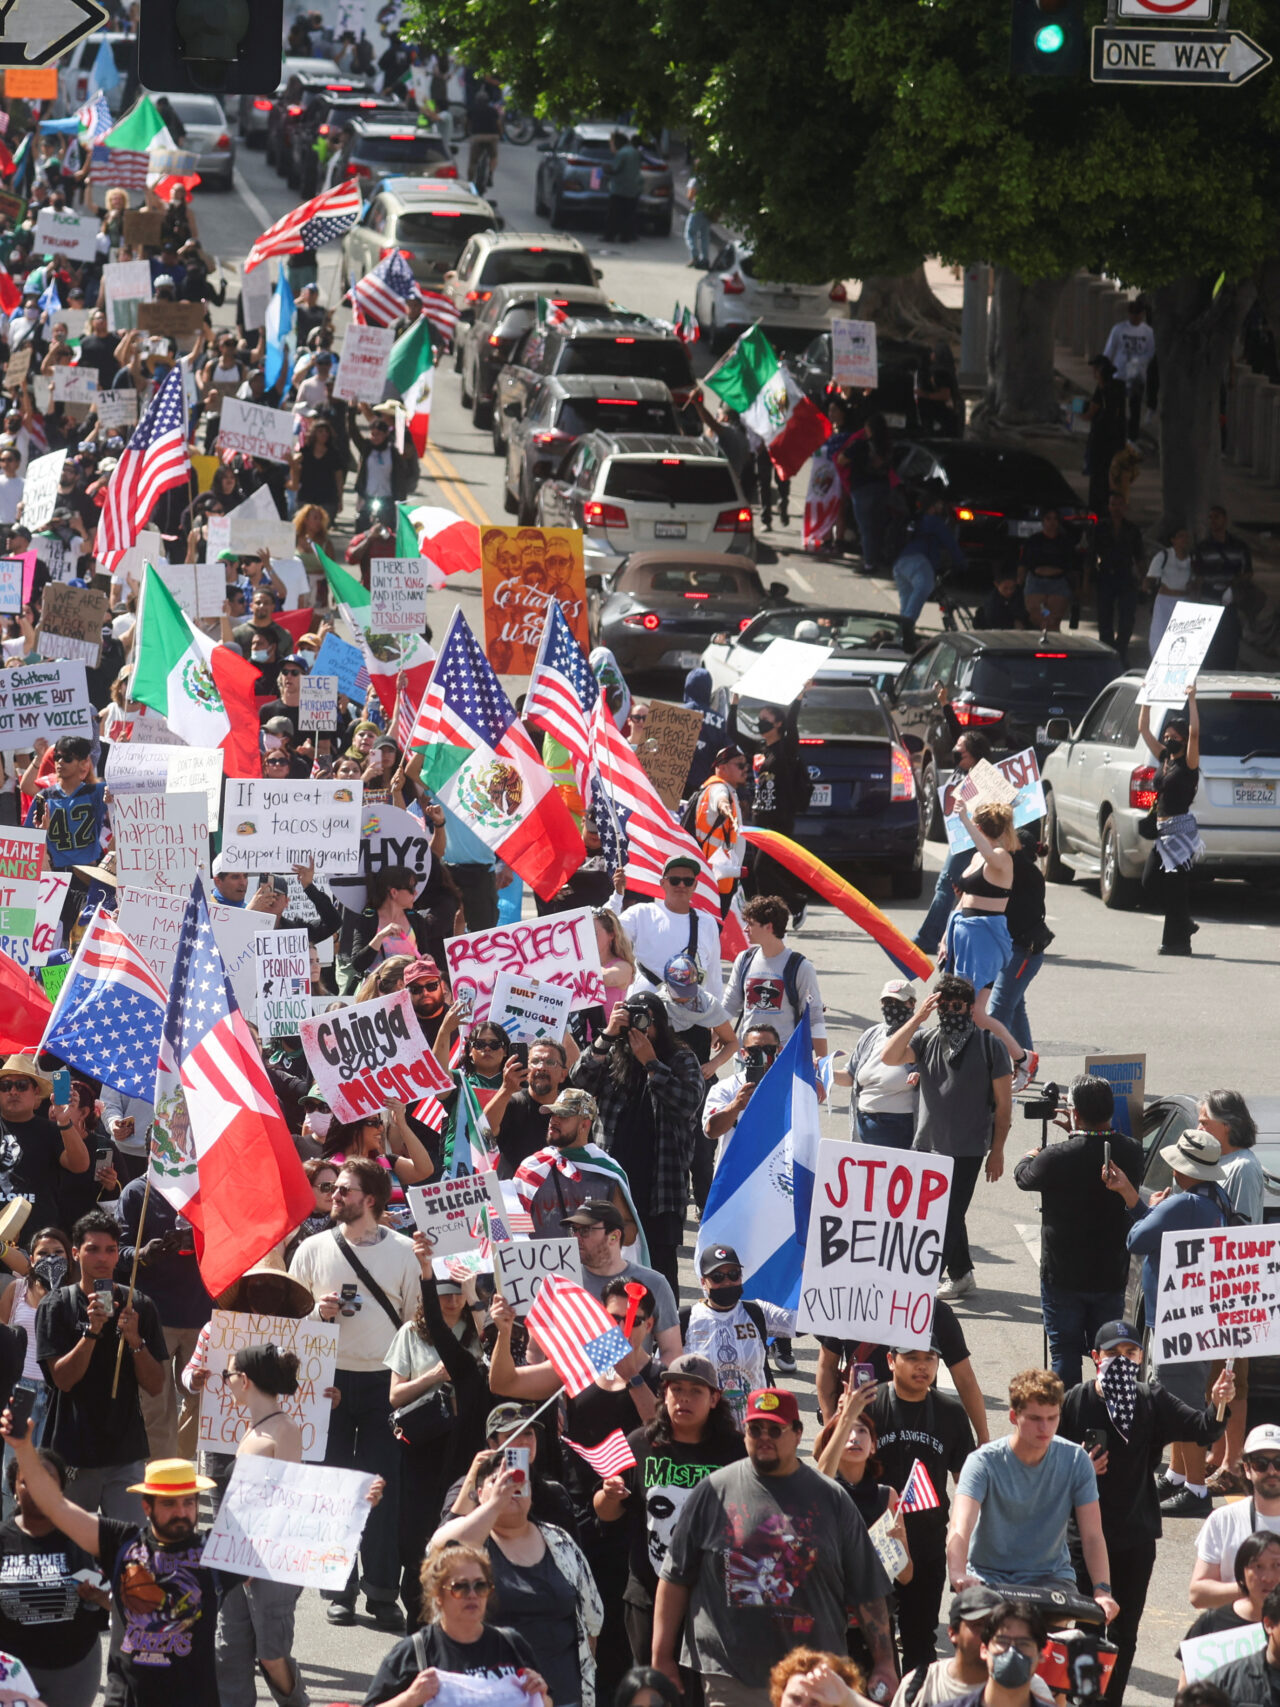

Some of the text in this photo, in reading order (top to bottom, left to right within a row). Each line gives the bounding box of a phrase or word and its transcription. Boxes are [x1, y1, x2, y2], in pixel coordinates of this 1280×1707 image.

[1106, 42, 1227, 69] ONE WAY
[239, 406, 276, 428] VIVA
[303, 677, 331, 690] ICE
[13, 690, 48, 705] HOME
[51, 688, 75, 704] BUT
[19, 713, 40, 729] MY
[44, 708, 87, 727] VOICE
[310, 711, 331, 719] NOT
[116, 795, 167, 821] What
[236, 783, 322, 809] If you eat
[48, 803, 95, 851] 42
[192, 822, 209, 840] to
[272, 812, 349, 838] tacos you
[118, 847, 199, 871] LIBERTY
[226, 845, 358, 869] Support immigrants
[256, 936, 272, 956] DE
[447, 914, 587, 972] RESPECT
[279, 978, 288, 997] A
[510, 986, 564, 1007] BUILT FROM
[318, 1003, 412, 1065] Chinga
[337, 1048, 452, 1116] migra!
[421, 1175, 485, 1198] NO ONE IS
[824, 1156, 948, 1221] STOP
[424, 1187, 491, 1216] ILLEGAL
[446, 1209, 465, 1221] ON
[498, 1244, 576, 1273] FUCK
[820, 1215, 943, 1277] BEING
[1175, 1238, 1205, 1269] IF
[1163, 1263, 1260, 1292] A BIG PARADE
[1209, 1281, 1261, 1303] HONOR
[1161, 1292, 1276, 1324] ALL HE HAS TO DO
[248, 1314, 271, 1334] NO
[273, 1317, 301, 1336] HAY
[735, 1323, 757, 1340] ES
[301, 1334, 337, 1357] PARA
[199, 1415, 217, 1442] EL
[899, 1429, 945, 1455] ANGELES
